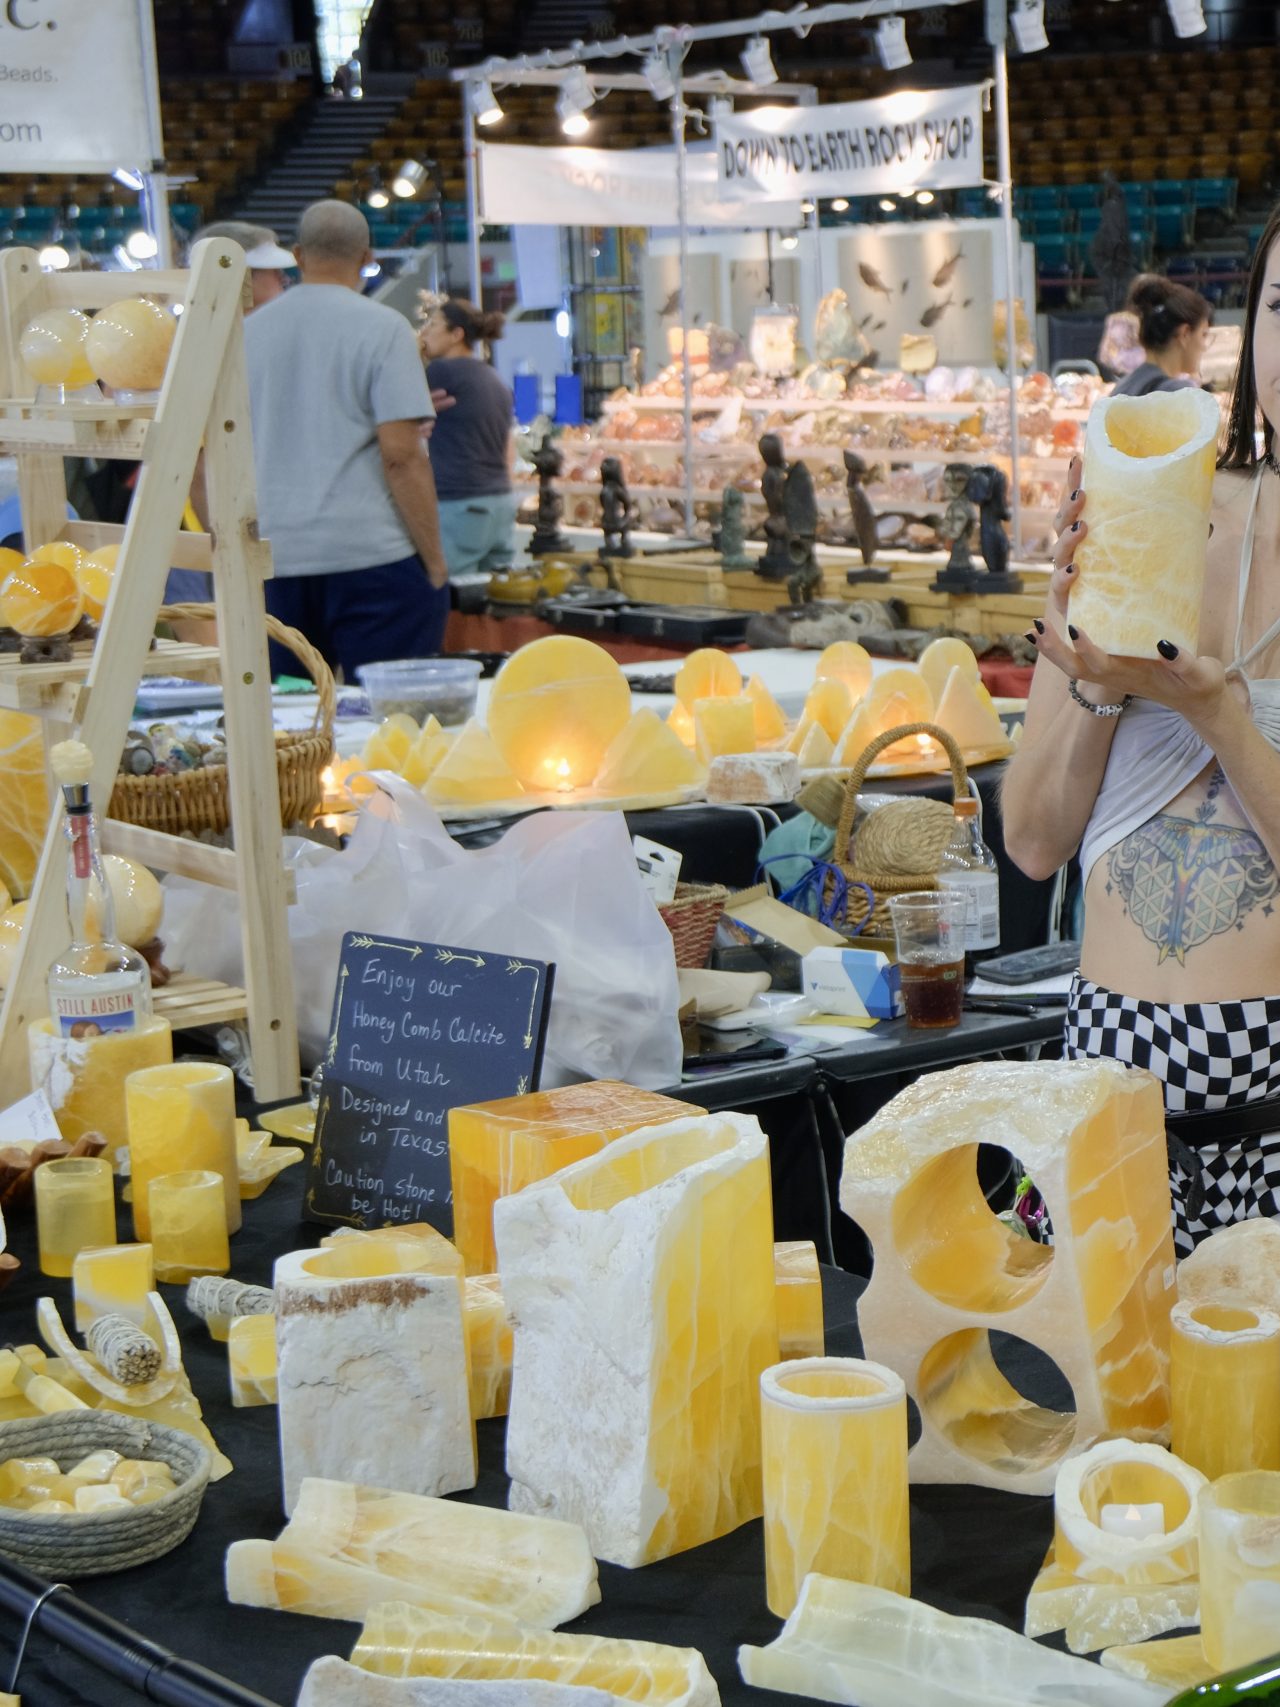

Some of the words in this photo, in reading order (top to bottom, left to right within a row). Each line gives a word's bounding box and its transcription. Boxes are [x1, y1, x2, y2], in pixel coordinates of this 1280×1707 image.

[426, 48, 449, 66] 105
[723, 134, 778, 179] DOWN
[779, 134, 803, 173] TO
[803, 127, 866, 173] EARTH
[923, 115, 974, 160] SHOP
[361, 958, 416, 1002] Enjoy
[428, 980, 462, 996] our
[57, 998, 87, 1014] STILL
[92, 992, 134, 1013] AUSTIN
[352, 1001, 395, 1044] Honey
[402, 1011, 441, 1041] Comb
[449, 1016, 506, 1045] Calcite
[349, 1043, 383, 1076] from
[397, 1057, 451, 1087] Utah
[341, 1085, 410, 1126] Designed
[414, 1102, 446, 1125] and
[359, 1126, 376, 1146] in
[325, 1159, 385, 1192] Caution
[395, 1173, 435, 1202] stone
[352, 1196, 376, 1214] be
[383, 1198, 421, 1221] Hot!
